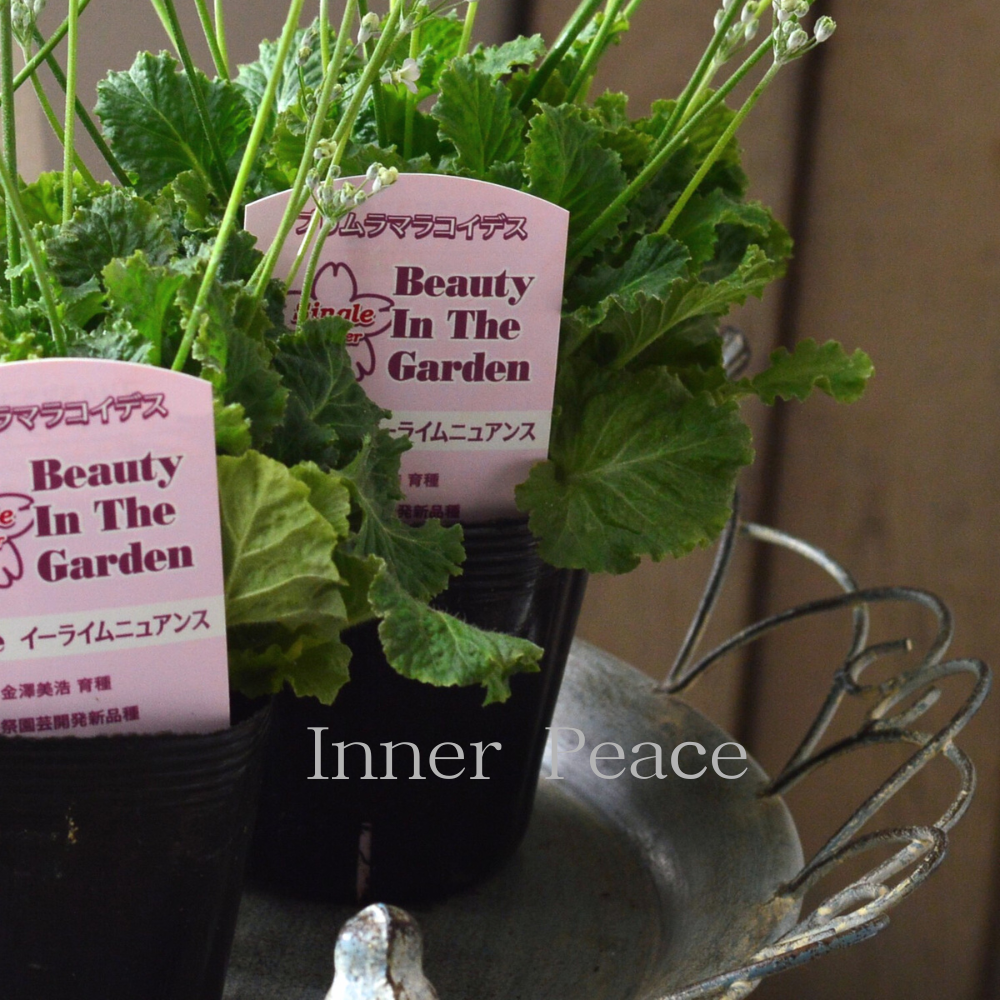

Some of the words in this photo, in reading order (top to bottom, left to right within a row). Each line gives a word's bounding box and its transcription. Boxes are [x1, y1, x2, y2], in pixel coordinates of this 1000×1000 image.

[295, 208, 528, 240] プムラマラコイデス
[392, 266, 535, 305] Beauty
[390, 308, 434, 340] In
[447, 310, 520, 340] The
[388, 350, 531, 382] Garden
[29, 451, 183, 492] Beauty
[33, 504, 80, 537] In
[95, 497, 175, 531] The
[37, 542, 194, 583] Garden
[20, 609, 211, 650] イーライムニュアンス
[77, 675, 112, 693] 育種
